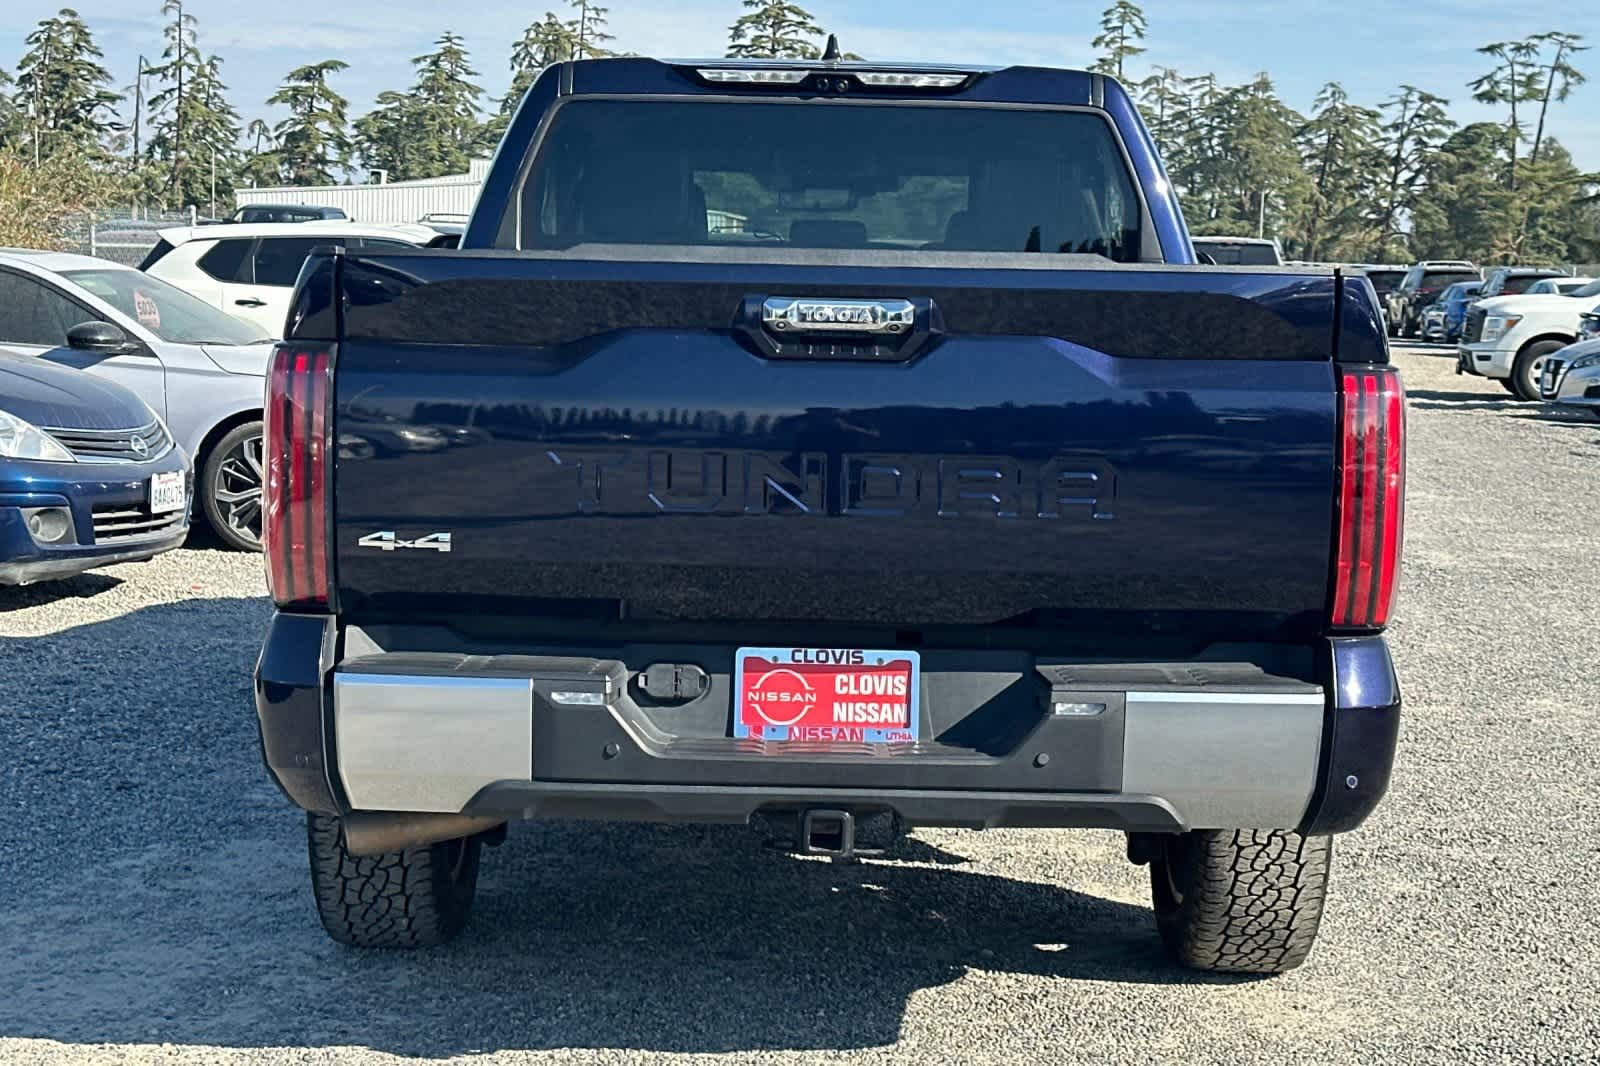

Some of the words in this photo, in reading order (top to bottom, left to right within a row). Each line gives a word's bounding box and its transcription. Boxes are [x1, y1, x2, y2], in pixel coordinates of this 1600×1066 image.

[804, 305, 873, 322] TOYOTA
[548, 450, 1119, 519] TUNDRA
[791, 649, 865, 665] CLOVIS
[835, 674, 907, 696] CLOVIS
[748, 691, 816, 702] NISSAN
[833, 702, 907, 723] NISSAN
[788, 727, 864, 741] NISSAN
